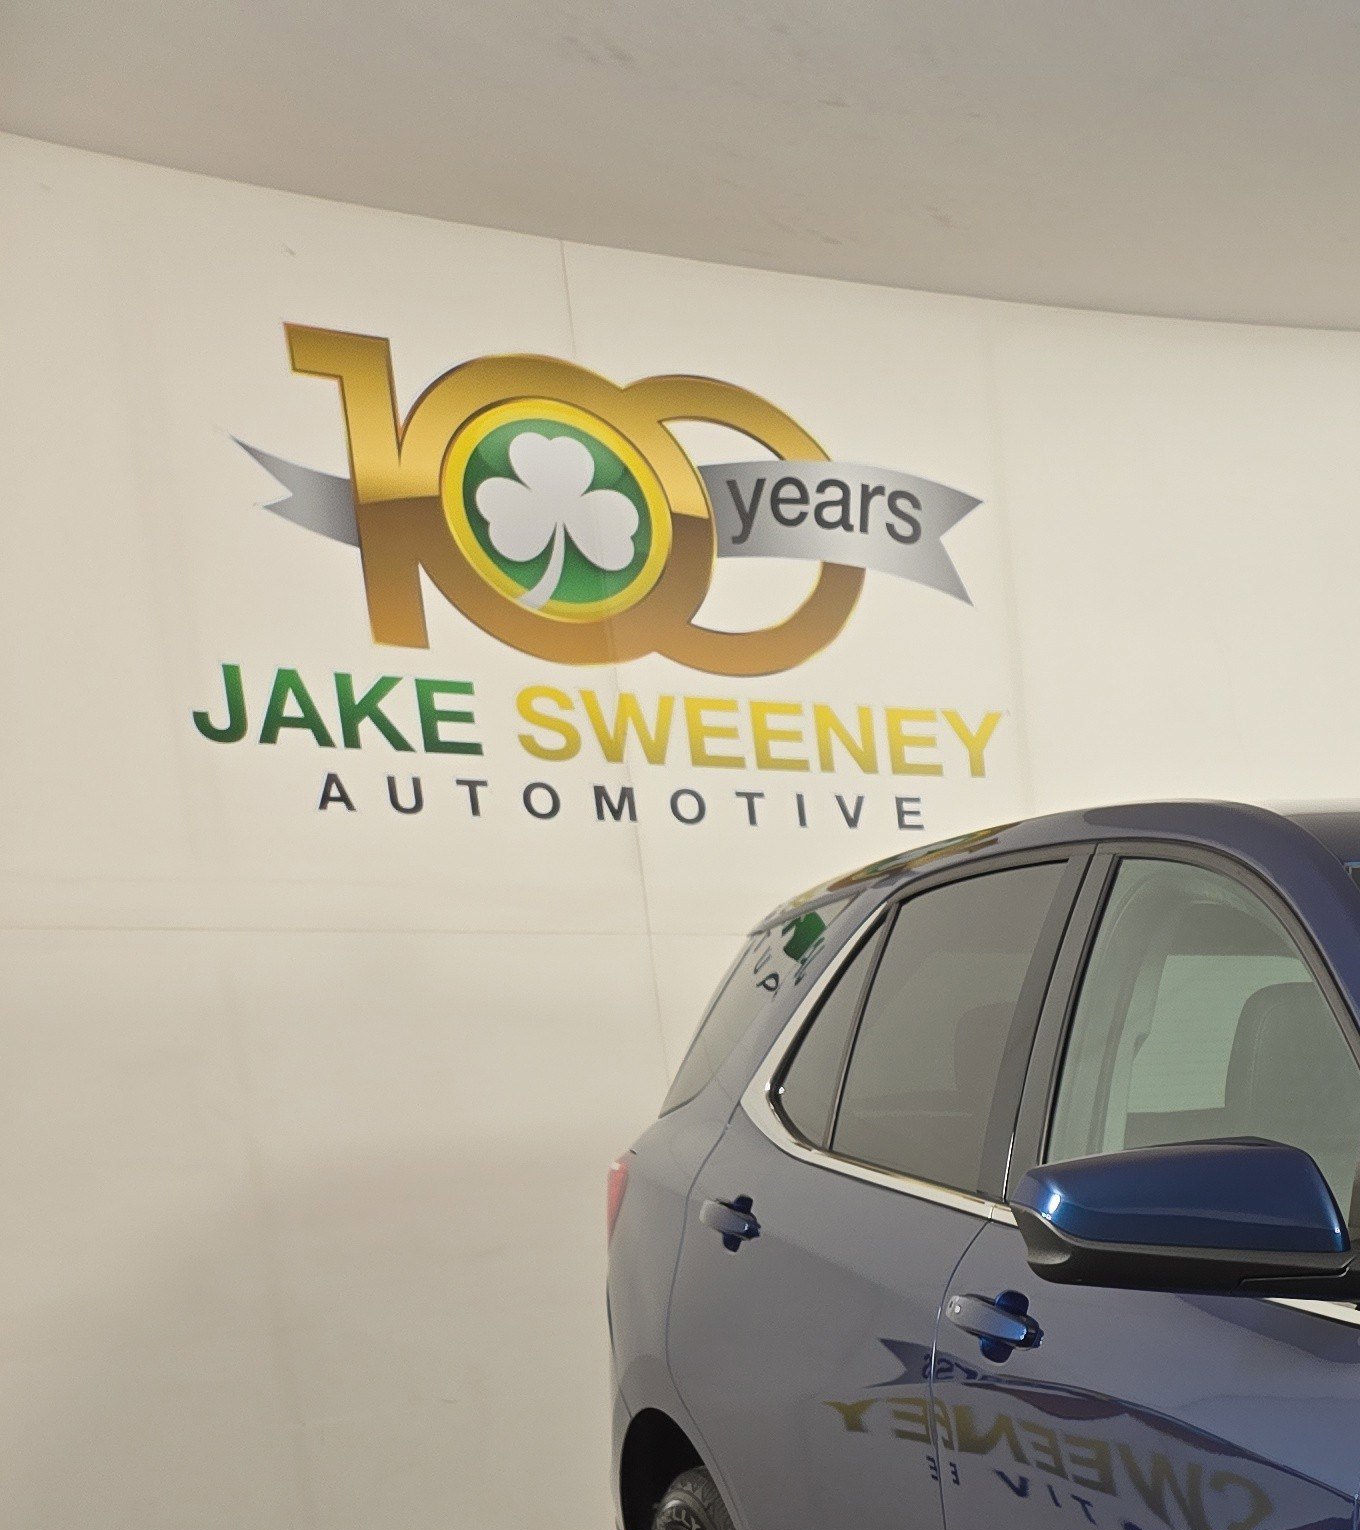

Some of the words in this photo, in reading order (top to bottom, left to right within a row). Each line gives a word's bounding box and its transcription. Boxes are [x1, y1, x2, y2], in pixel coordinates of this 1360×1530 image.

[726, 475, 924, 545] years
[192, 663, 484, 757] JAKE
[517, 684, 1004, 778] SWEENEY
[318, 772, 926, 831] AUTOMOTIVE
